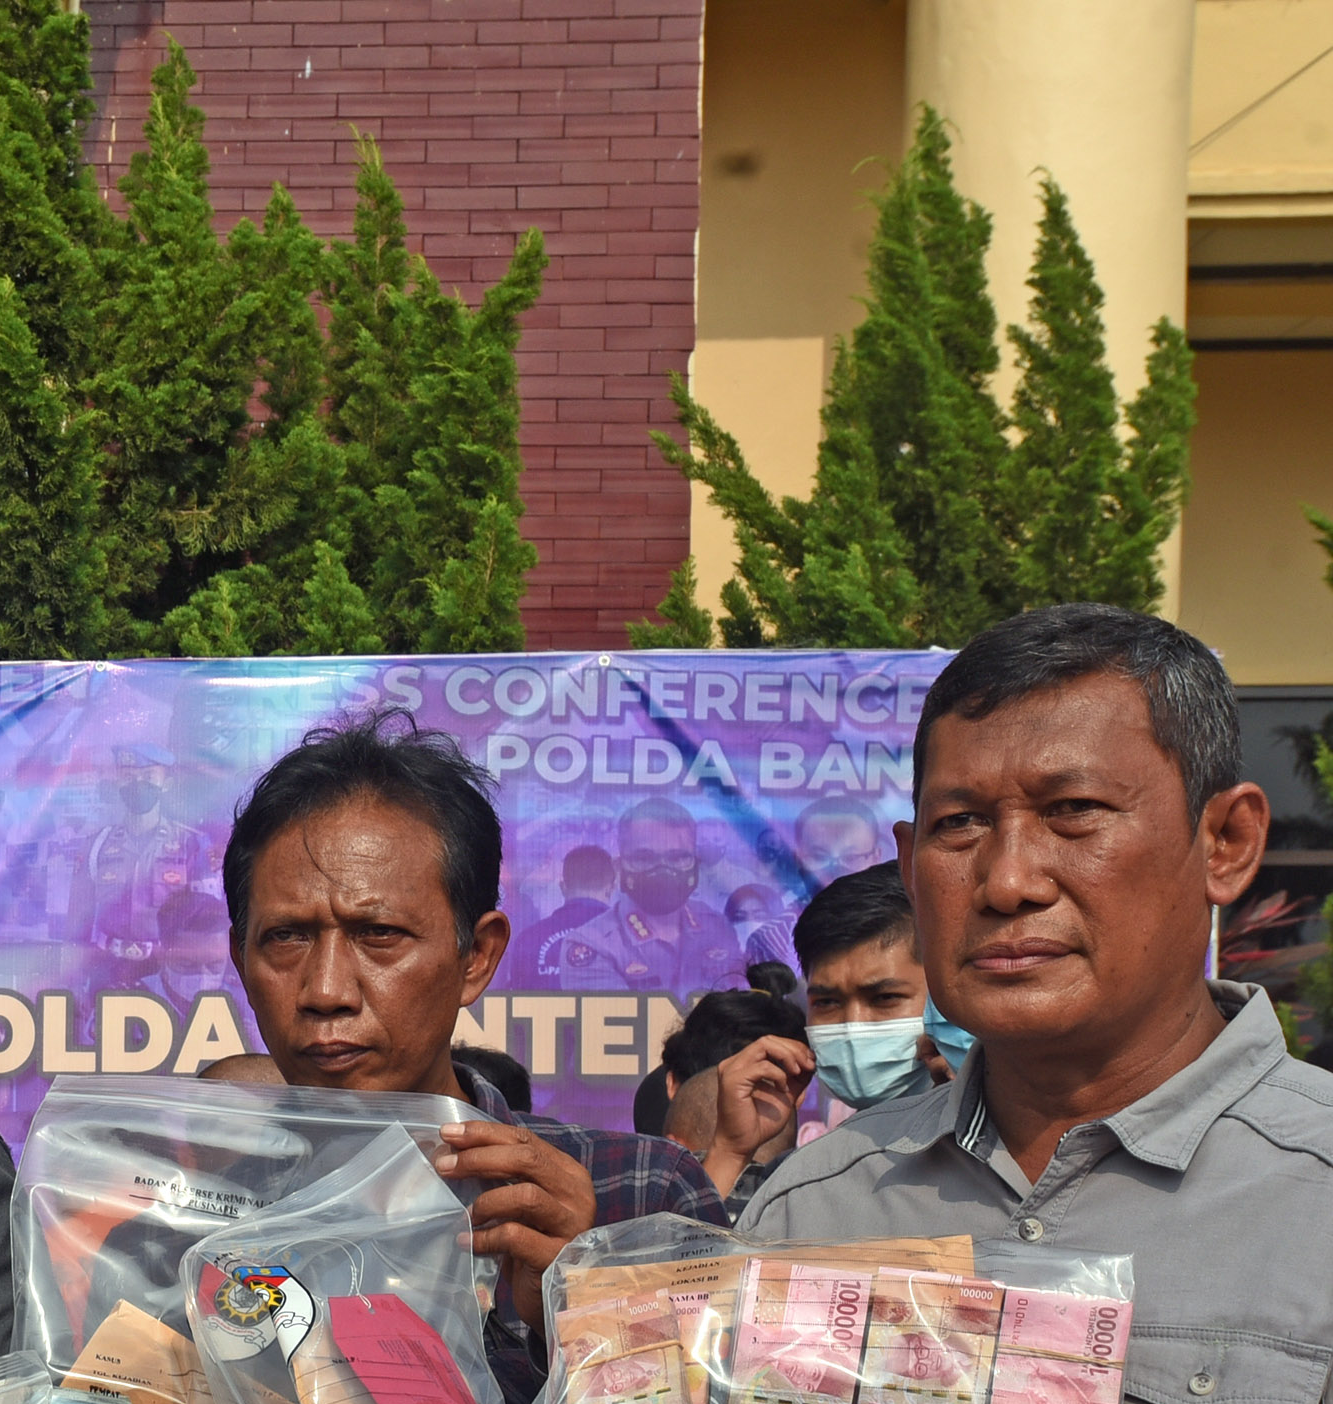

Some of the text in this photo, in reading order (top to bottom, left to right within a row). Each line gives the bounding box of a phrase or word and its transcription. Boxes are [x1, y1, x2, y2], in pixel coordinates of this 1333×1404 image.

[445, 664, 927, 726] CONFERENCE
[488, 734, 737, 789] POLDA
[759, 741, 915, 792] BAN
[215, 1191, 265, 1209] KRIMINAL
[675, 1261, 721, 1274] KEJADIAN
[670, 1274, 720, 1287] LOKASI BB
[697, 1292, 710, 1302] BB
[959, 1286, 994, 1302] 100000
[627, 1300, 660, 1317] 100000
[830, 1279, 862, 1353] 100000
[95, 1353, 122, 1365] KASUS
